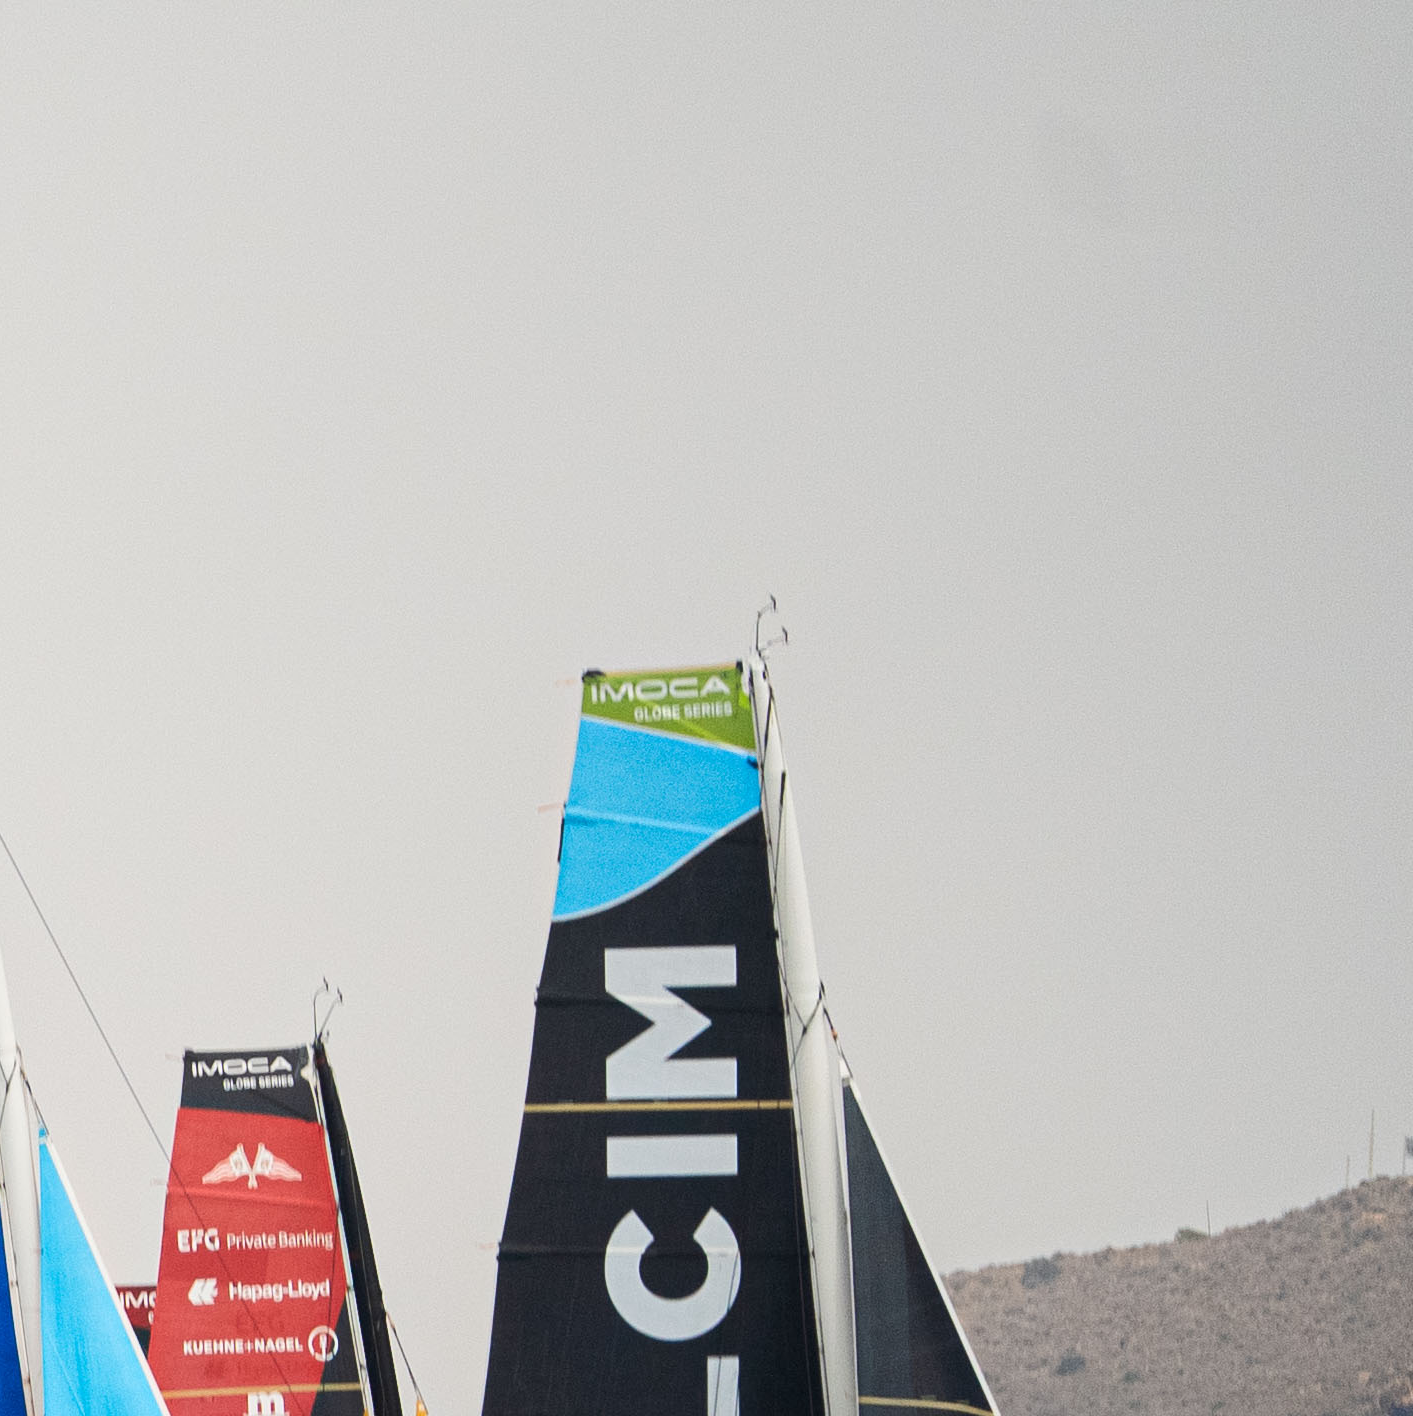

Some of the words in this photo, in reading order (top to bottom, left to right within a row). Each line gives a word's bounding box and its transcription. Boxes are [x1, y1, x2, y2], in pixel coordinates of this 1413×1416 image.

[591, 675, 731, 705] IMOCA
[634, 704, 681, 723] GLOBE
[684, 701, 733, 718] SERIES
[191, 1056, 293, 1078] IMOCA
[223, 1076, 257, 1092] GLOBE
[258, 1074, 294, 1089] SERIES
[177, 1228, 220, 1252] EFG
[226, 1231, 276, 1250] Private
[278, 1229, 334, 1251] Banking
[228, 1278, 331, 1303] Hapag-Lloyd
[183, 1337, 304, 1356] KUEHNE+NAGEL
